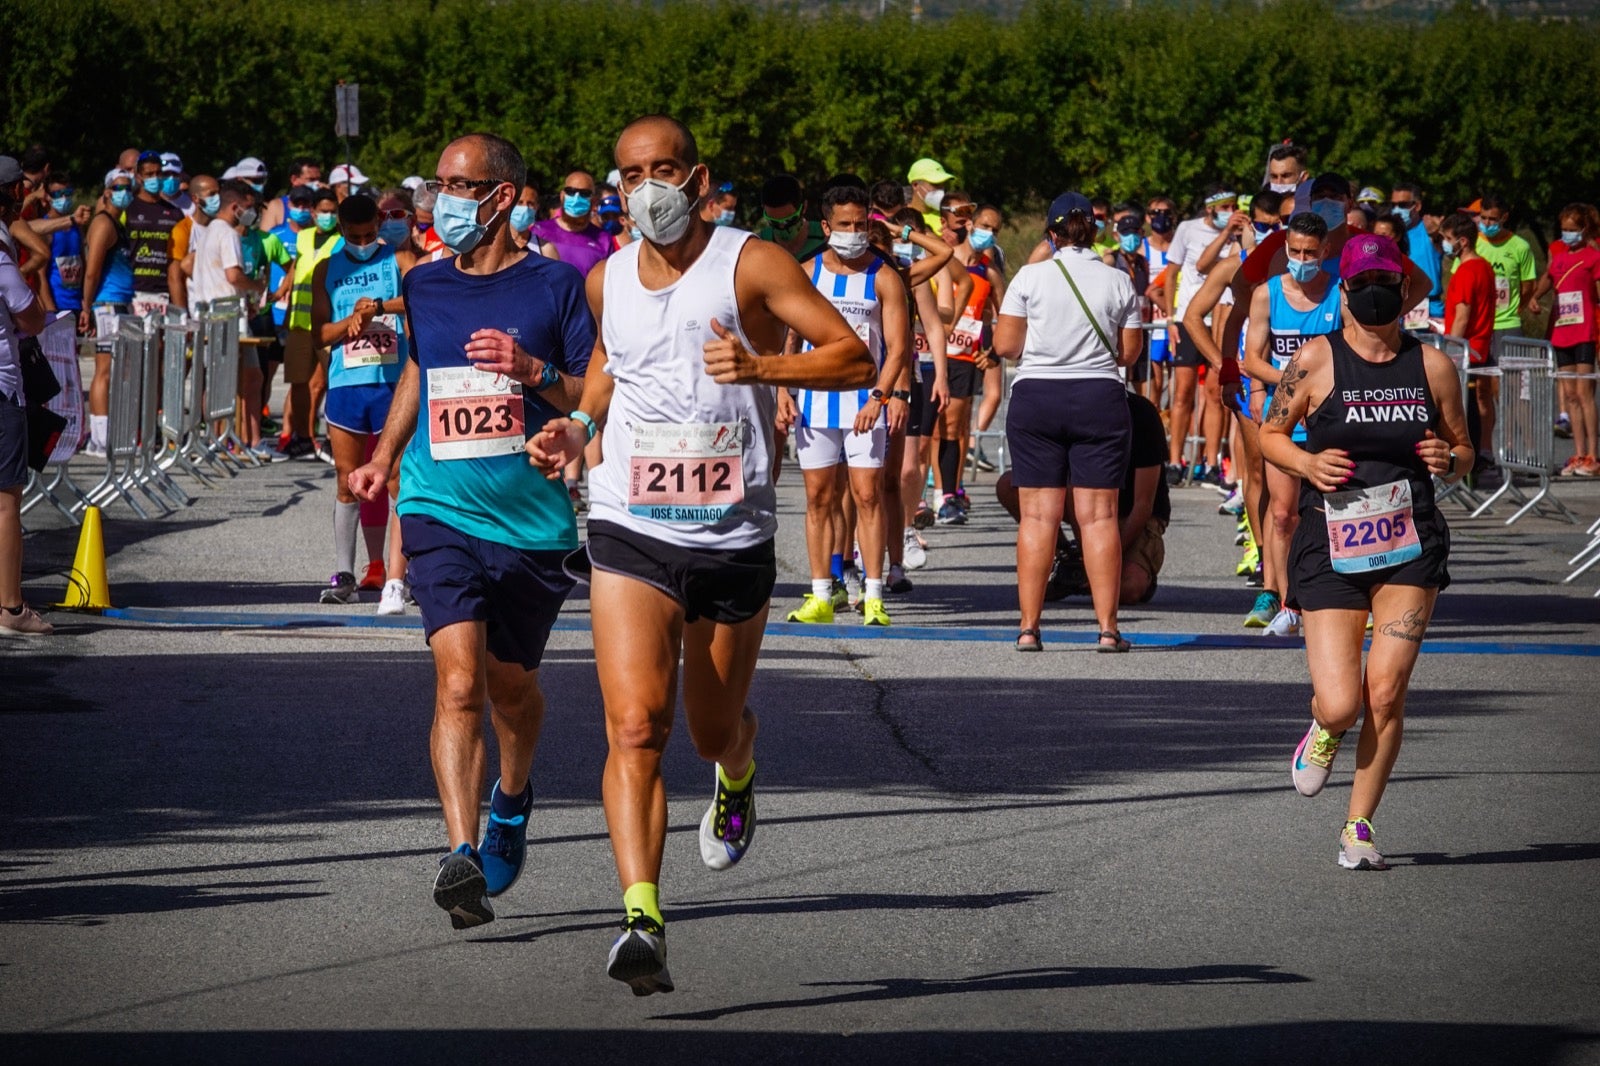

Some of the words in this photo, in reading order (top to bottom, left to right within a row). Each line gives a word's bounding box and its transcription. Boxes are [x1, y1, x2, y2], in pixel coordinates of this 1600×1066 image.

[333, 271, 379, 289] nerja
[842, 306, 872, 317] PAZITO
[351, 333, 393, 351] 2233
[1342, 390, 1362, 402] BE
[1364, 387, 1425, 402] POSITIVE
[438, 404, 514, 437] 1023
[1345, 404, 1429, 424] ALWAYS
[646, 461, 732, 493] 2112
[650, 506, 673, 520] JOSÉ
[675, 507, 723, 521] SANTIAGO
[1341, 513, 1407, 548] 2205
[1368, 554, 1388, 568] DORI
